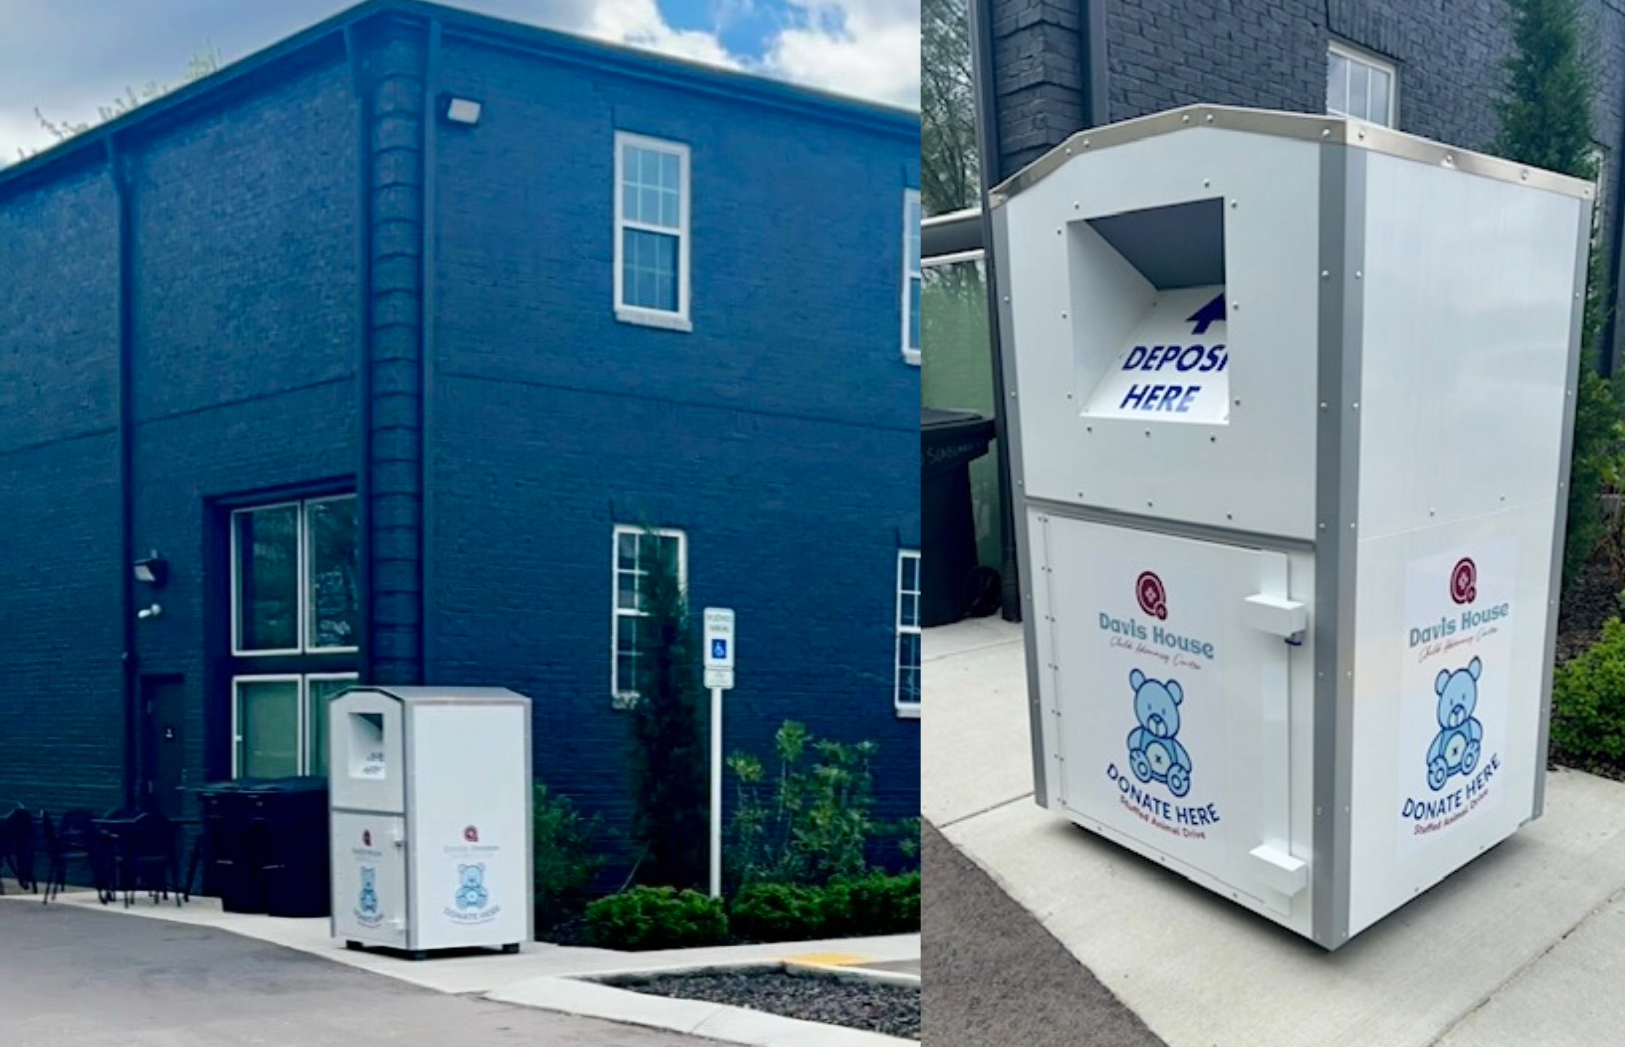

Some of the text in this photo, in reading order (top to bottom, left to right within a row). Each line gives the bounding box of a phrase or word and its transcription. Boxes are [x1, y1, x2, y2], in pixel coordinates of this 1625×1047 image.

[1121, 344, 1228, 371] DEPOSI
[1119, 384, 1201, 412] HERE
[1099, 612, 1147, 640] Davis
[1153, 625, 1214, 660] House
[1410, 616, 1457, 648] Davis
[1461, 602, 1509, 630] House
[1107, 762, 1220, 826] DONATE HERE
[1402, 752, 1500, 820] DONATE HERE
[1120, 794, 1206, 839] Stuffed Animal Drive
